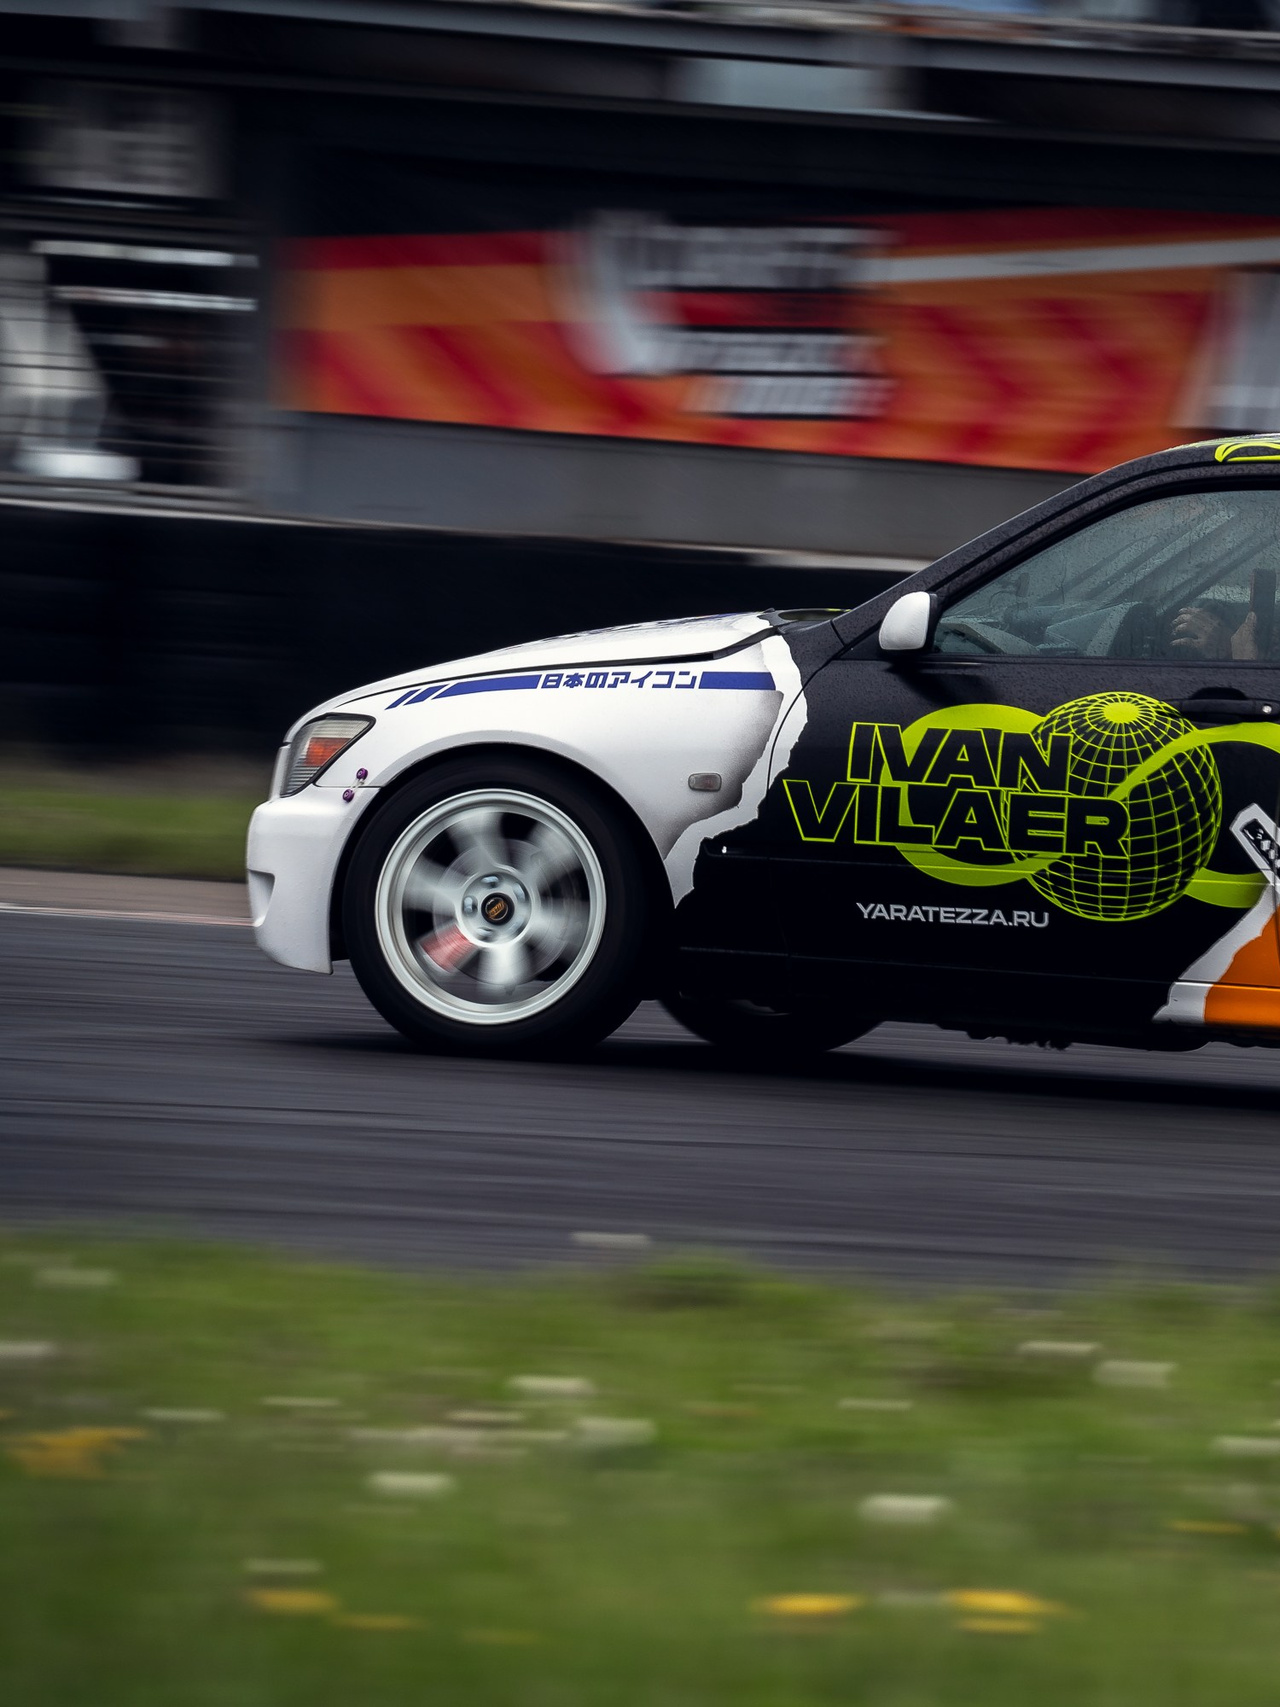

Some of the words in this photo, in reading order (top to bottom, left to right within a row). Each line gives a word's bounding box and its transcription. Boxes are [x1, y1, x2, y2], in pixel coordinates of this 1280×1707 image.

[541, 671, 697, 689] 日本のアイコン
[847, 722, 1074, 795] IVAN
[783, 779, 1131, 859] VILAER
[856, 902, 1050, 928] YARATEZZA.RU
